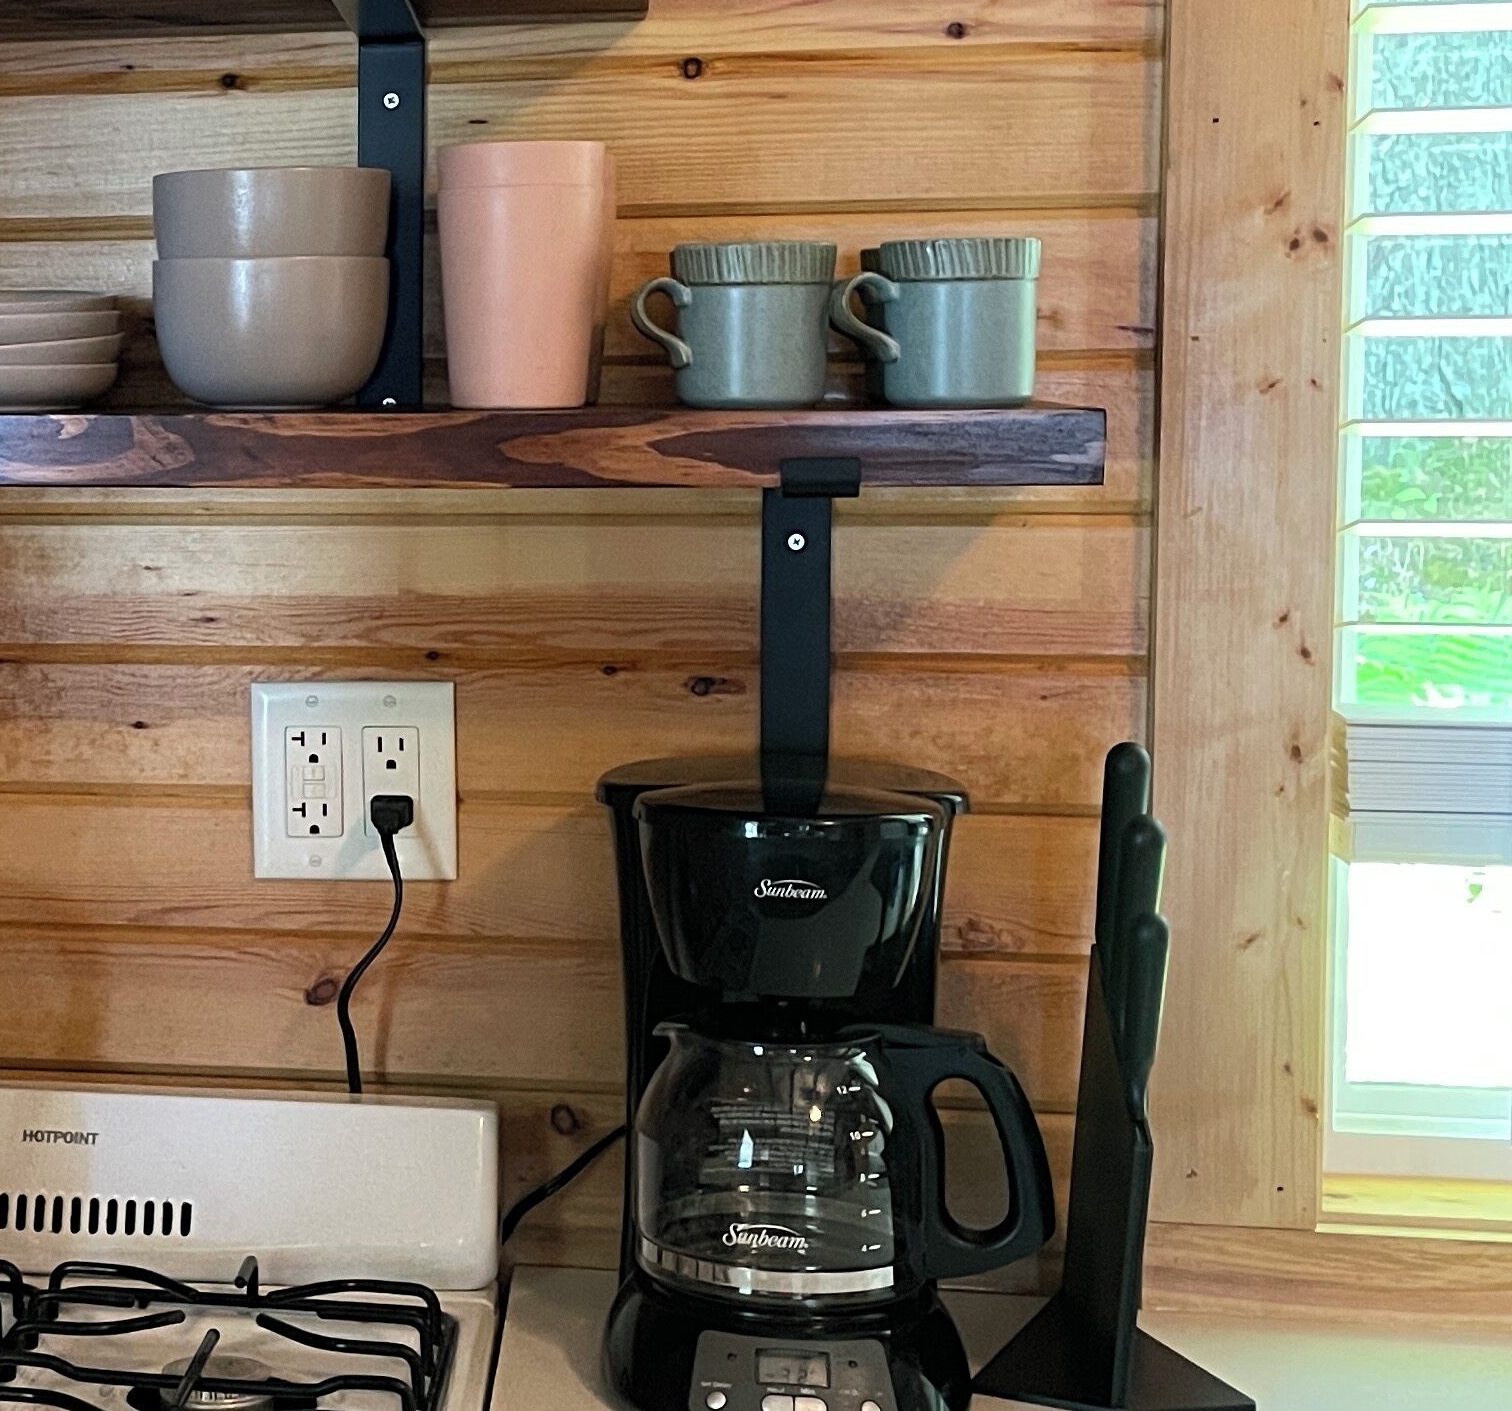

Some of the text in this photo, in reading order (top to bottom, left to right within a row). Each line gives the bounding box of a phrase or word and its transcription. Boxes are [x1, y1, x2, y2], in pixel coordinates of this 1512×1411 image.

[753, 878, 825, 899] Sunbeam
[22, 1129, 99, 1145] HOTPOINT
[722, 1222, 805, 1249] Sunbeam
